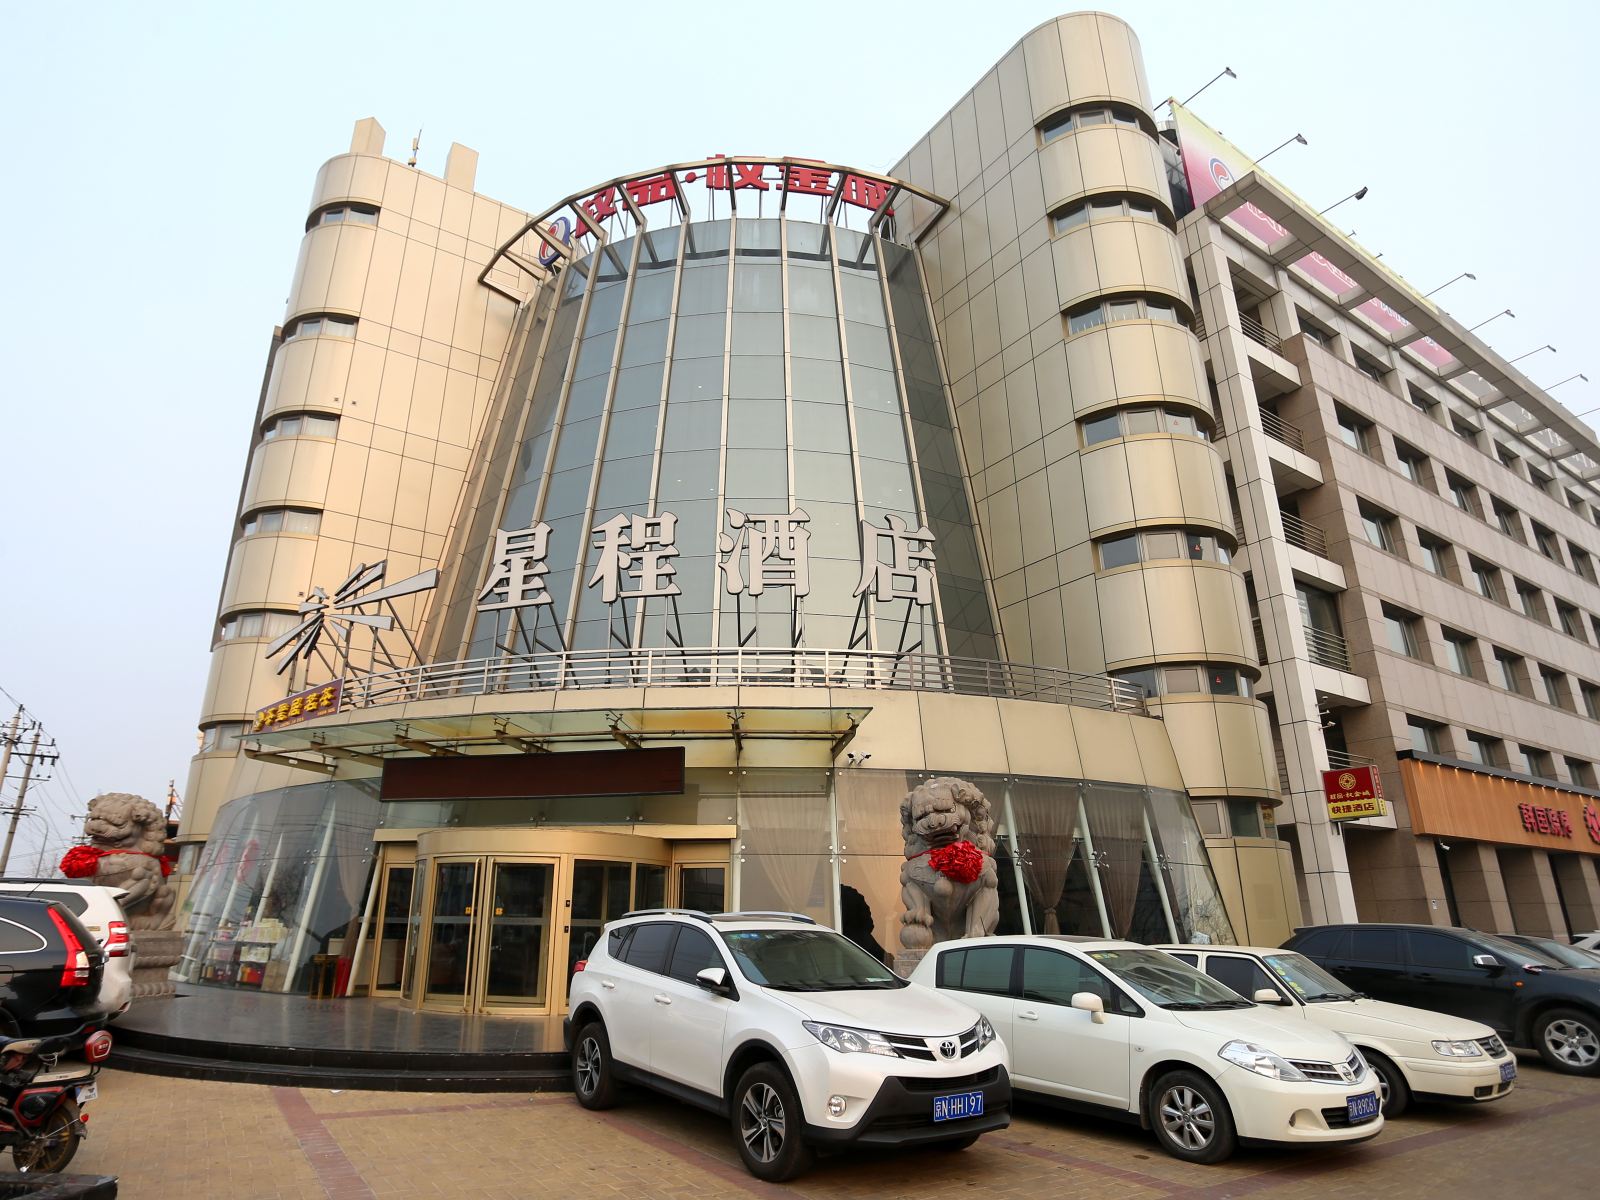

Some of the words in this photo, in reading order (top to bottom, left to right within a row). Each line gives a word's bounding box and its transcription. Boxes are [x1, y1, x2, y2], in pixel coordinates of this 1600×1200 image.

[477, 507, 936, 612] 星程酒店
[1331, 802, 1375, 814] 快捷酒店
